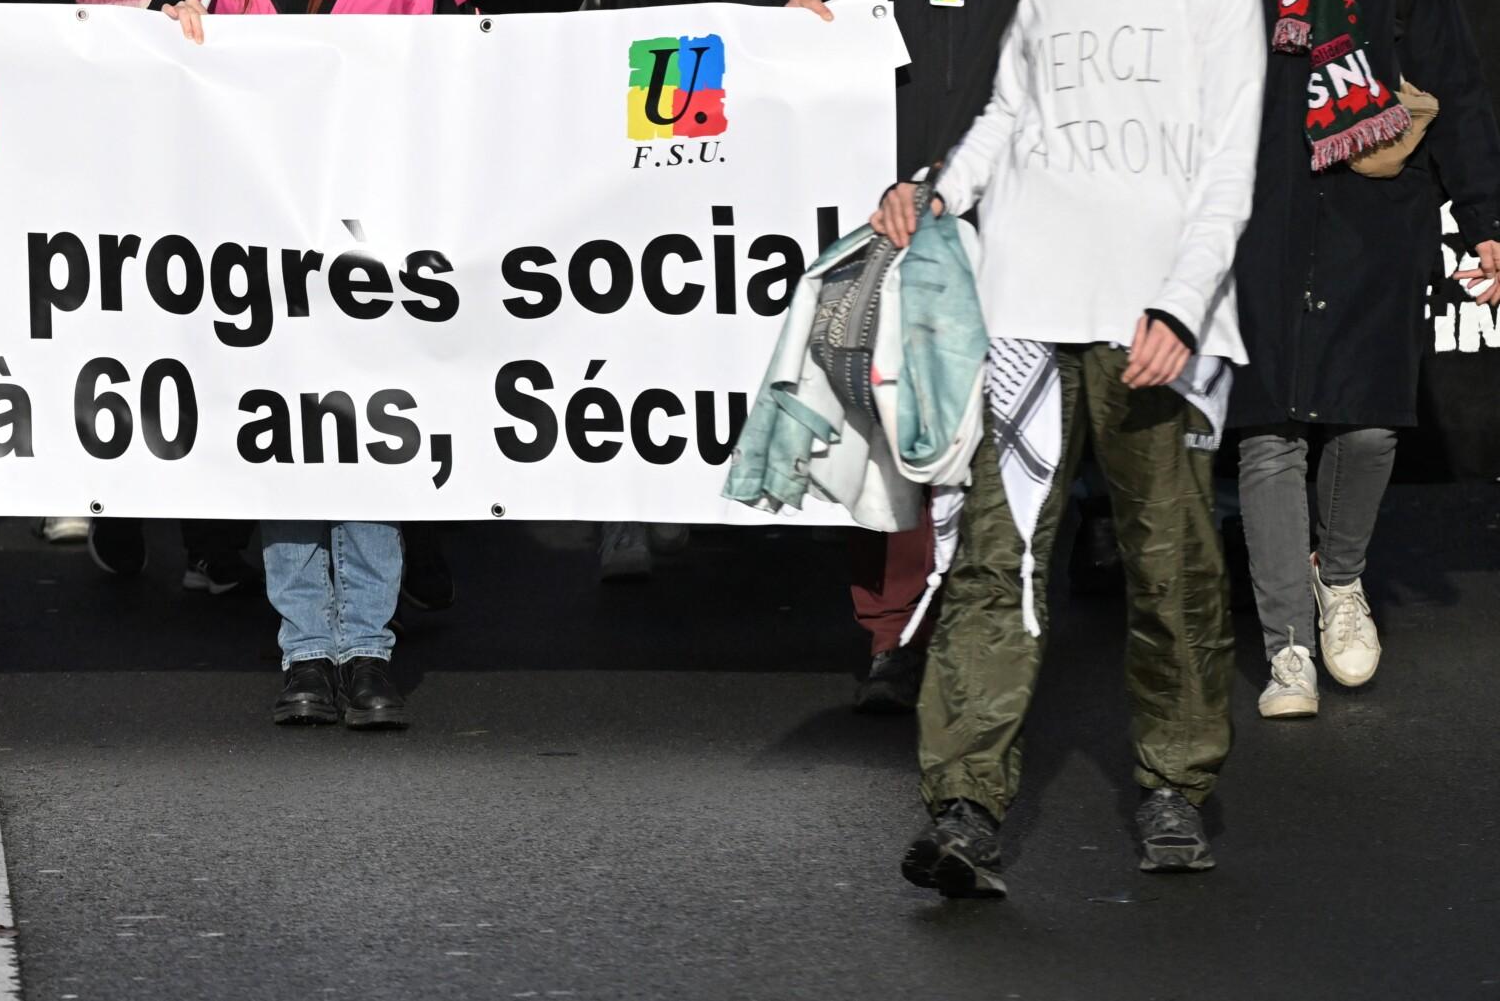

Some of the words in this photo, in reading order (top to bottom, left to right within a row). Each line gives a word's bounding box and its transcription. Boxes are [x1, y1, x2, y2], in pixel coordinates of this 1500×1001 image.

[631, 141, 726, 169] F.S.U.
[27, 219, 460, 348] progrès
[74, 357, 198, 460] 60
[237, 389, 453, 489] ans,
[494, 359, 748, 465] Sécu
